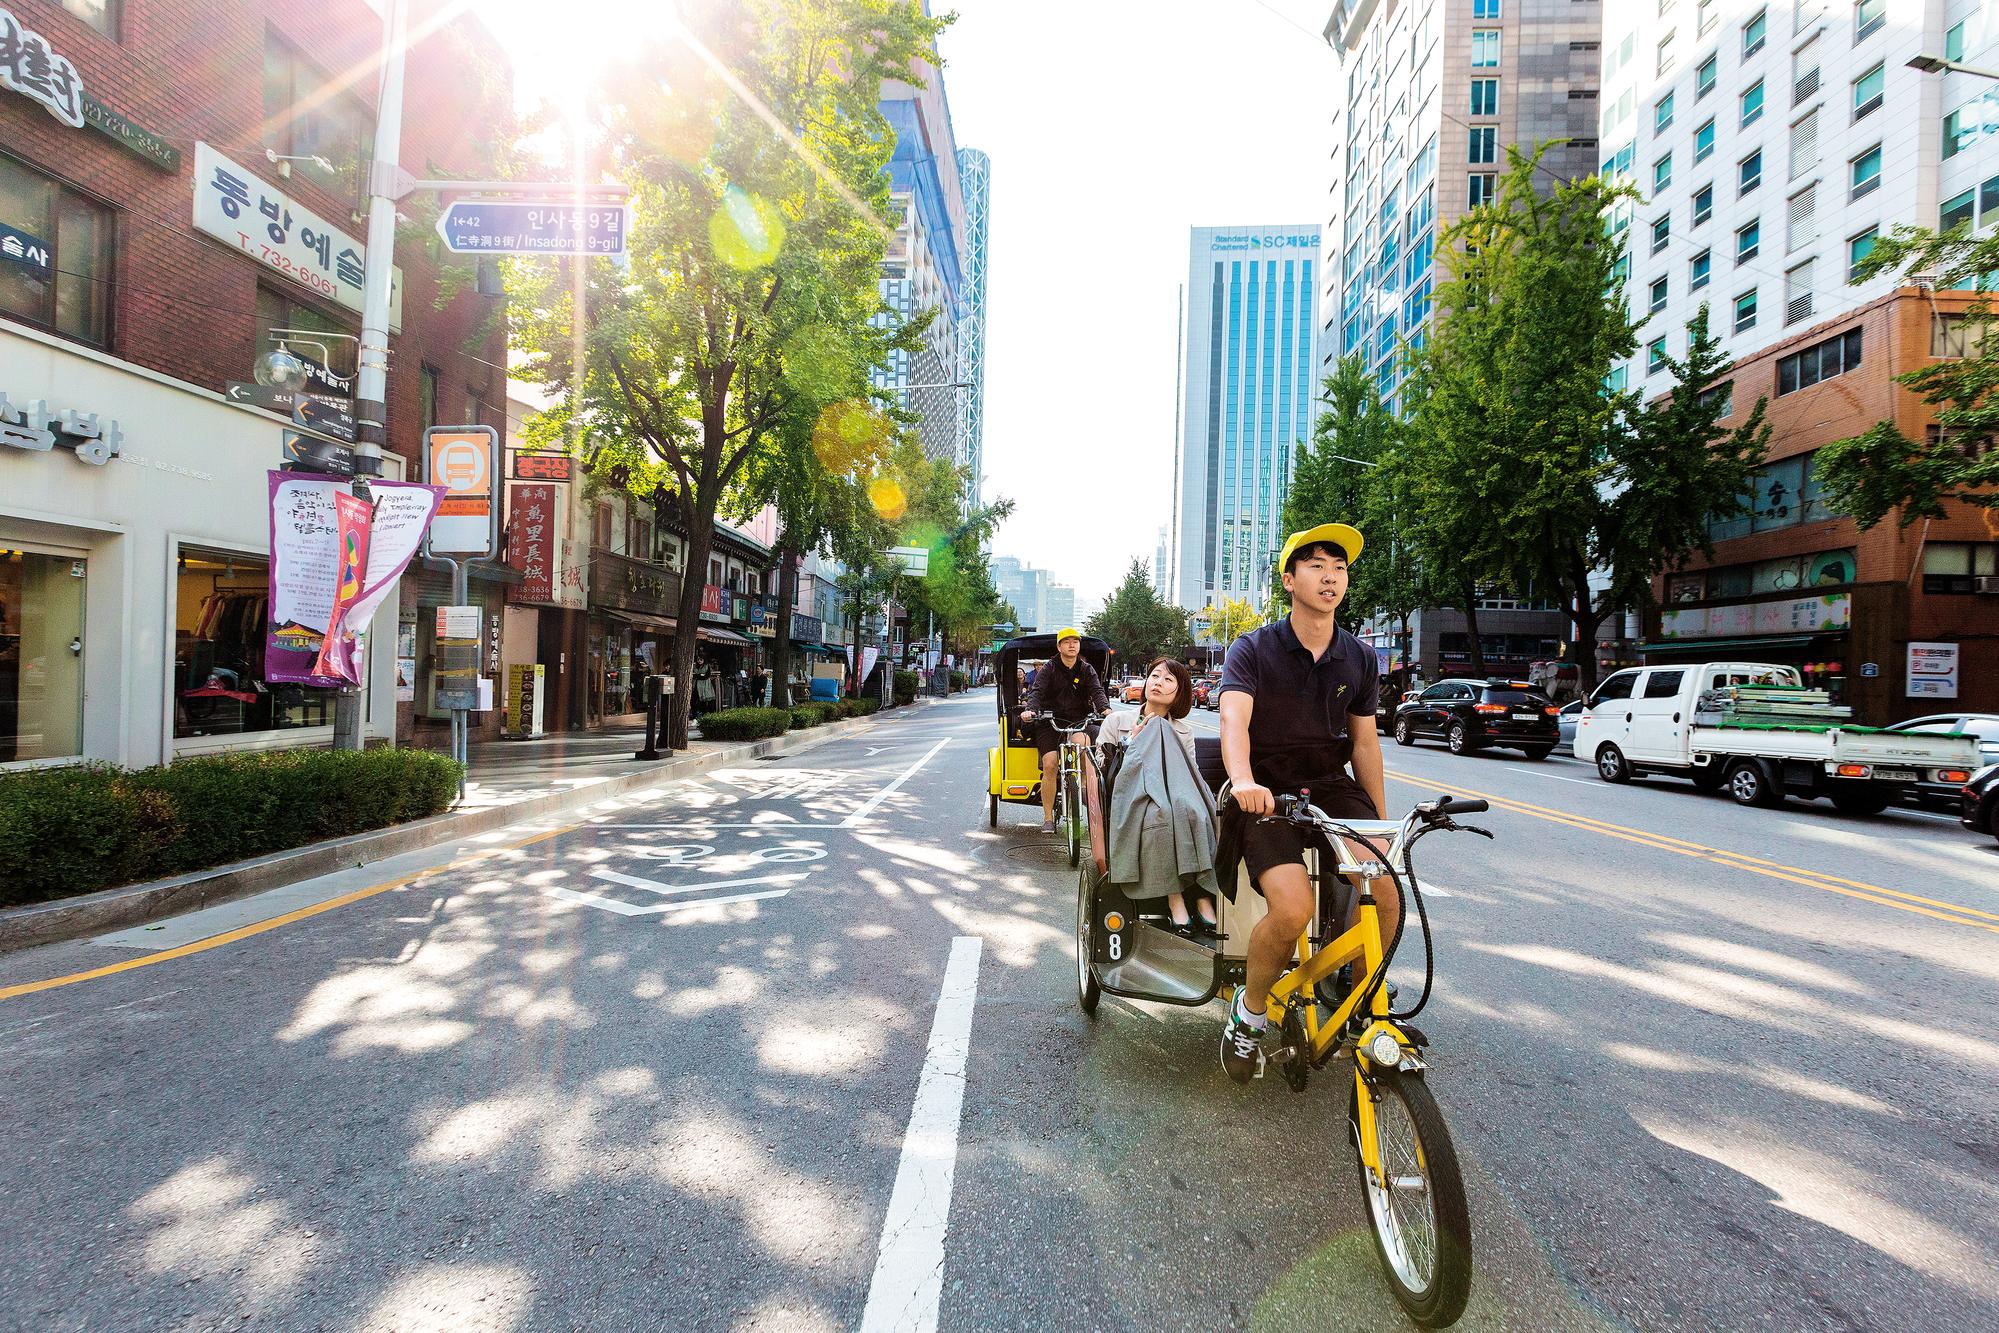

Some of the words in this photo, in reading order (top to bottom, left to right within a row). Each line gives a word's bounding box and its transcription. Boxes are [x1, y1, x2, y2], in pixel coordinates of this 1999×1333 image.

[211, 166, 396, 308] 동방예술
[588, 236, 618, 251] 9-gil
[1109, 934, 1122, 960] 8
